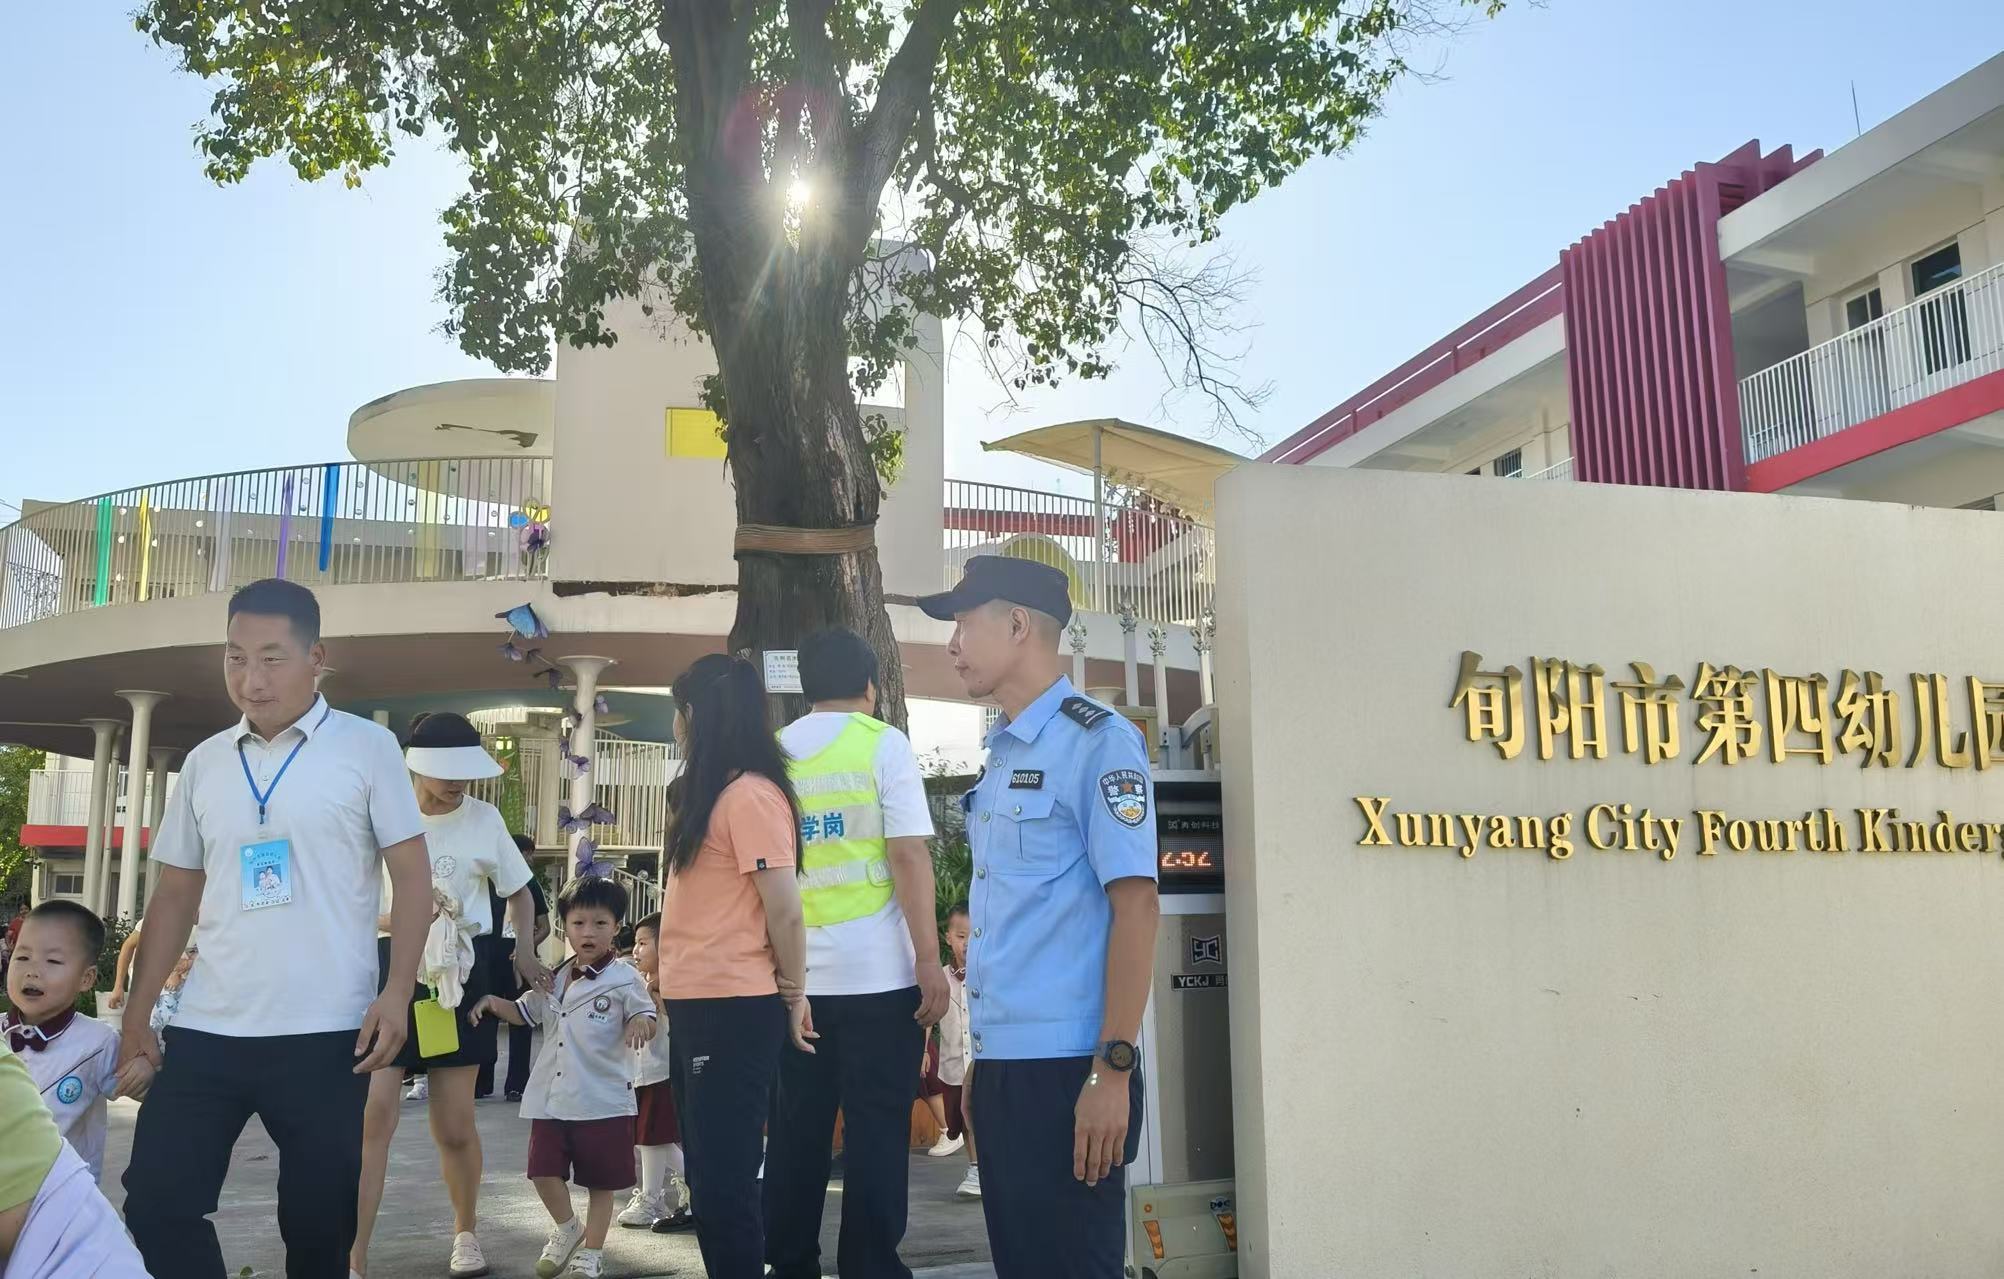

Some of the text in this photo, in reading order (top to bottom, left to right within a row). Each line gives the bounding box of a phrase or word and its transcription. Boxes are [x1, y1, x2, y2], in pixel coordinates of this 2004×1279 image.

[1012, 773, 1040, 784] 610105
[1353, 796, 2004, 861] Xunyang City Fourth Kinder
[1178, 975, 1209, 987] YCKJ
